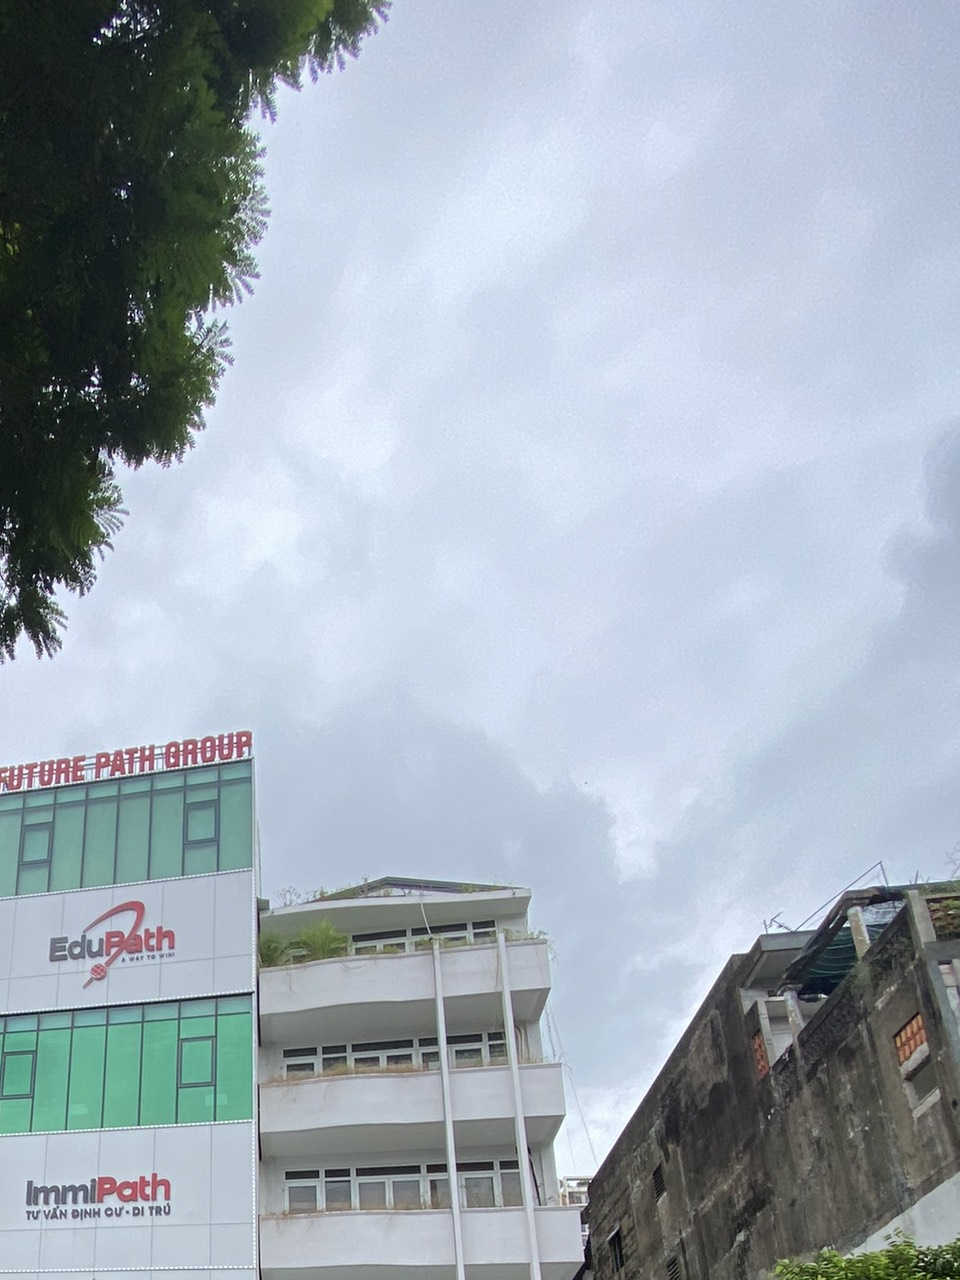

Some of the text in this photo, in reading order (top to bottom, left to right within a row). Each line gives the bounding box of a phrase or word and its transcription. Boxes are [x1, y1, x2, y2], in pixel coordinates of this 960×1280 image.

[94, 743, 155, 778] PATH
[164, 730, 252, 768] GROUP
[49, 926, 175, 962] EduPath
[26, 1173, 171, 1206] ImmiPath
[26, 1203, 171, 1221] TƯ VẤN ĐỊNH CƯ DI TRÚ
